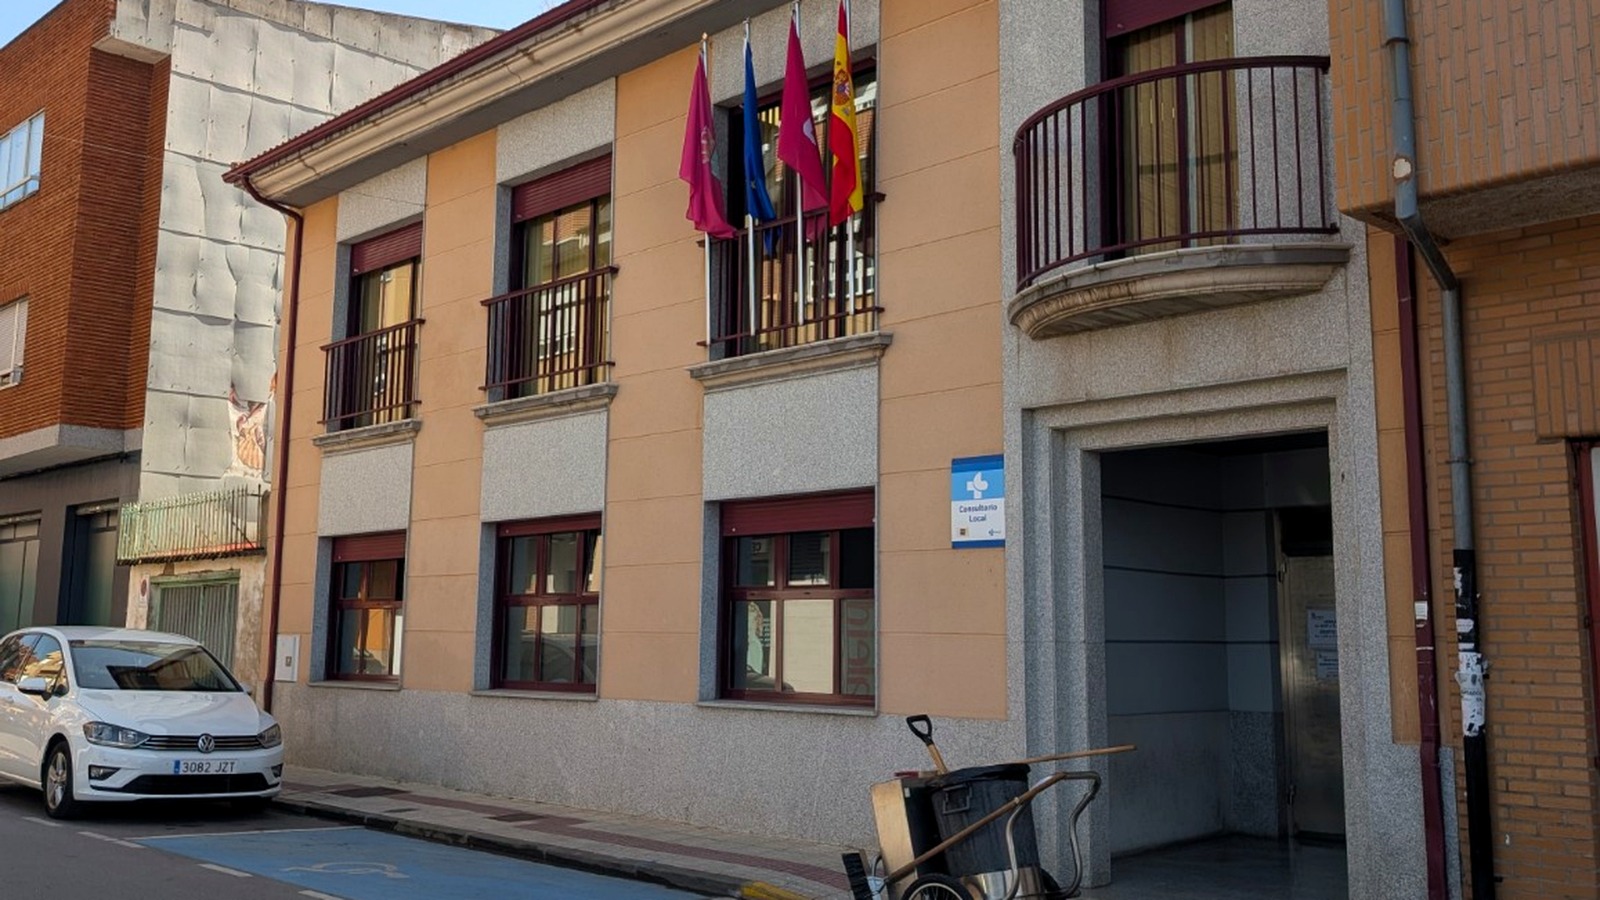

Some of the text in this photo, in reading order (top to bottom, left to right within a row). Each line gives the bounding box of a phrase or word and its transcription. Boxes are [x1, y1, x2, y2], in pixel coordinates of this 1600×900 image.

[959, 504, 998, 513] Consultorio
[969, 514, 987, 522] Local
[182, 761, 235, 773] 3082 JZT
